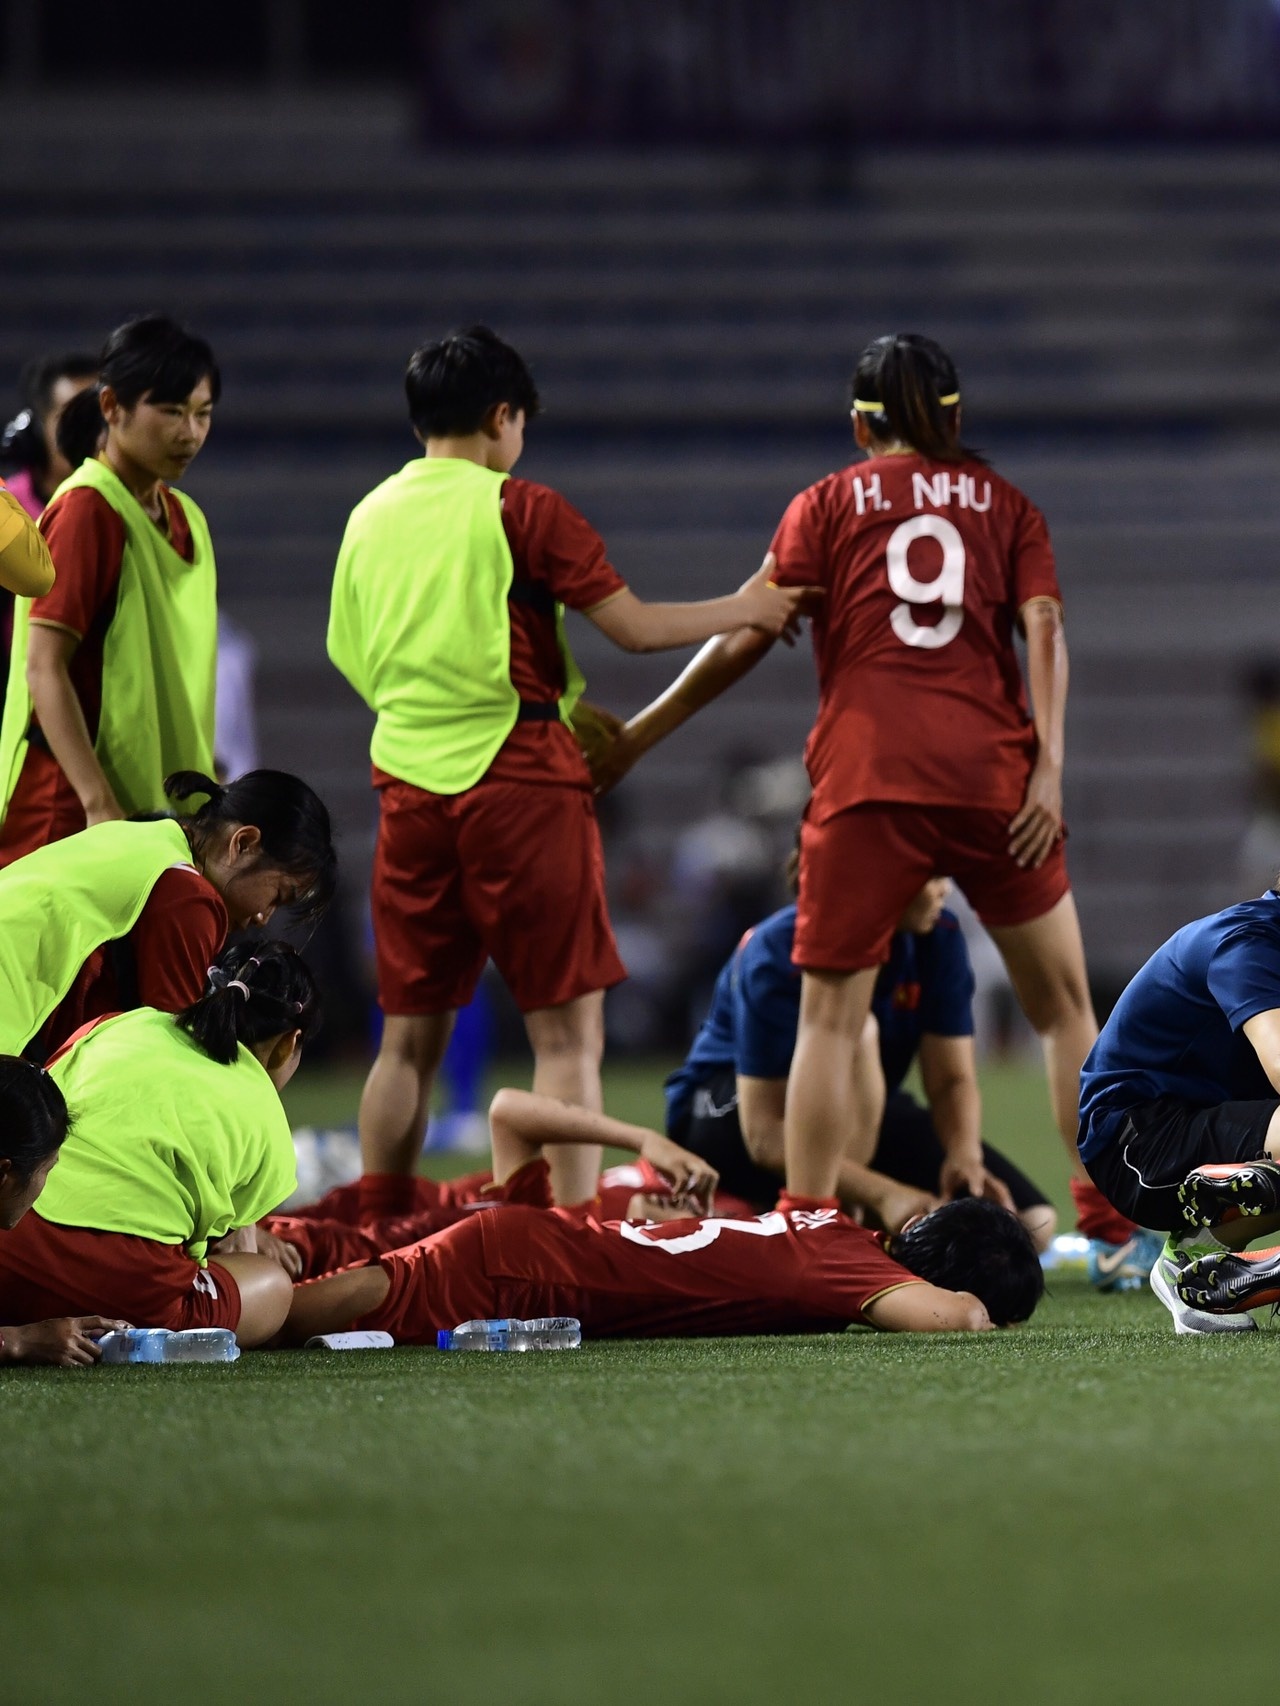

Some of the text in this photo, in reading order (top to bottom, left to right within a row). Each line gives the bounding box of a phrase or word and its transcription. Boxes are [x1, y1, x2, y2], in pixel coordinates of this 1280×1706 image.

[852, 472, 992, 516] H. NHU
[886, 513, 966, 649] 9
